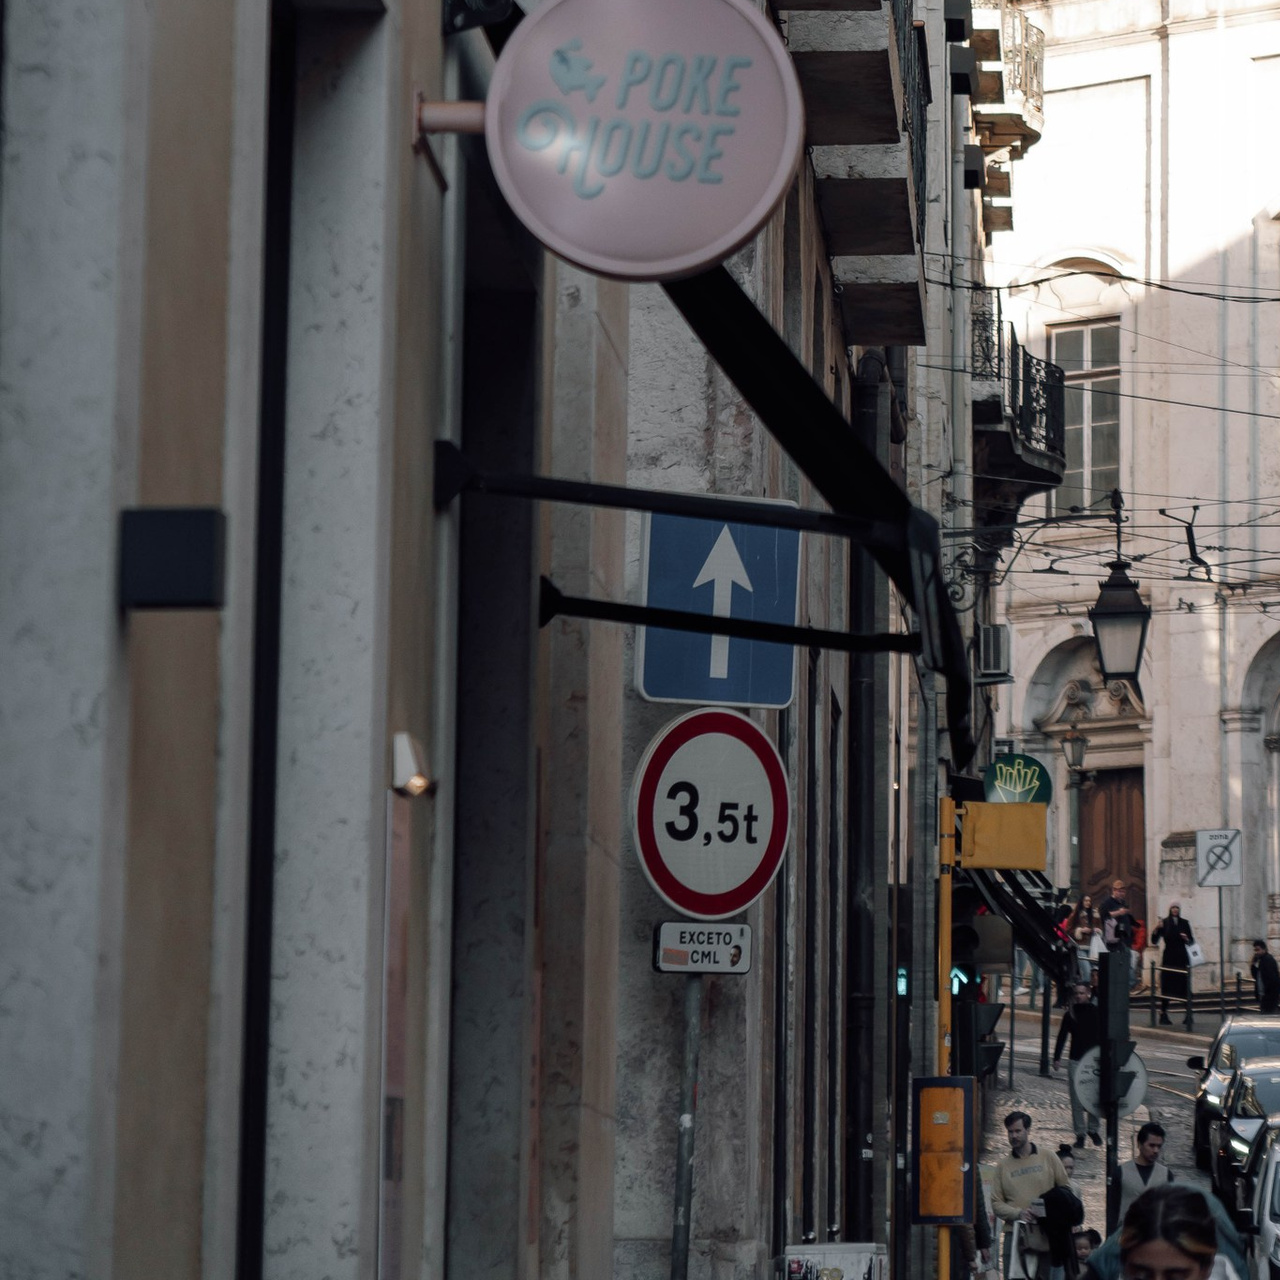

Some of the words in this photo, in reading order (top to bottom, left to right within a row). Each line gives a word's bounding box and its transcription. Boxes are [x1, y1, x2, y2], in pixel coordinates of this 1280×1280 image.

[615, 48, 753, 117] POKE
[517, 99, 736, 200] HOUSE
[665, 781, 759, 847] 3,5t
[679, 931, 733, 946] EXCETO
[690, 950, 721, 965] CML
